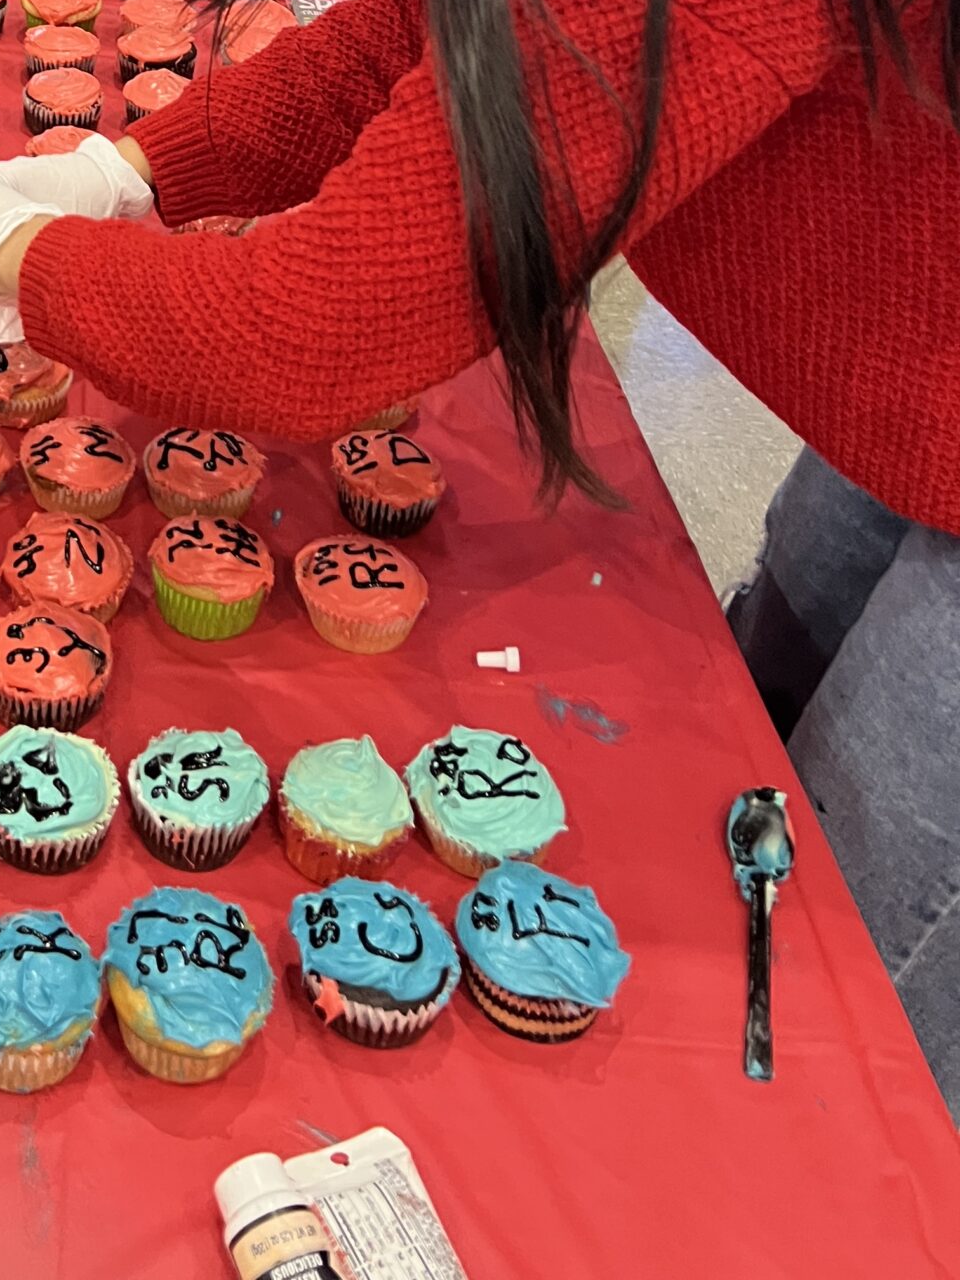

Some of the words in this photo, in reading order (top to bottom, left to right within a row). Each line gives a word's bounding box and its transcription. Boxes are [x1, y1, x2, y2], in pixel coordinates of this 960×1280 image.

[14, 925, 83, 961] K
[127, 909, 190, 976] 37
[189, 904, 251, 980] Rb
[304, 897, 339, 949] 55
[506, 883, 591, 948] Fr
